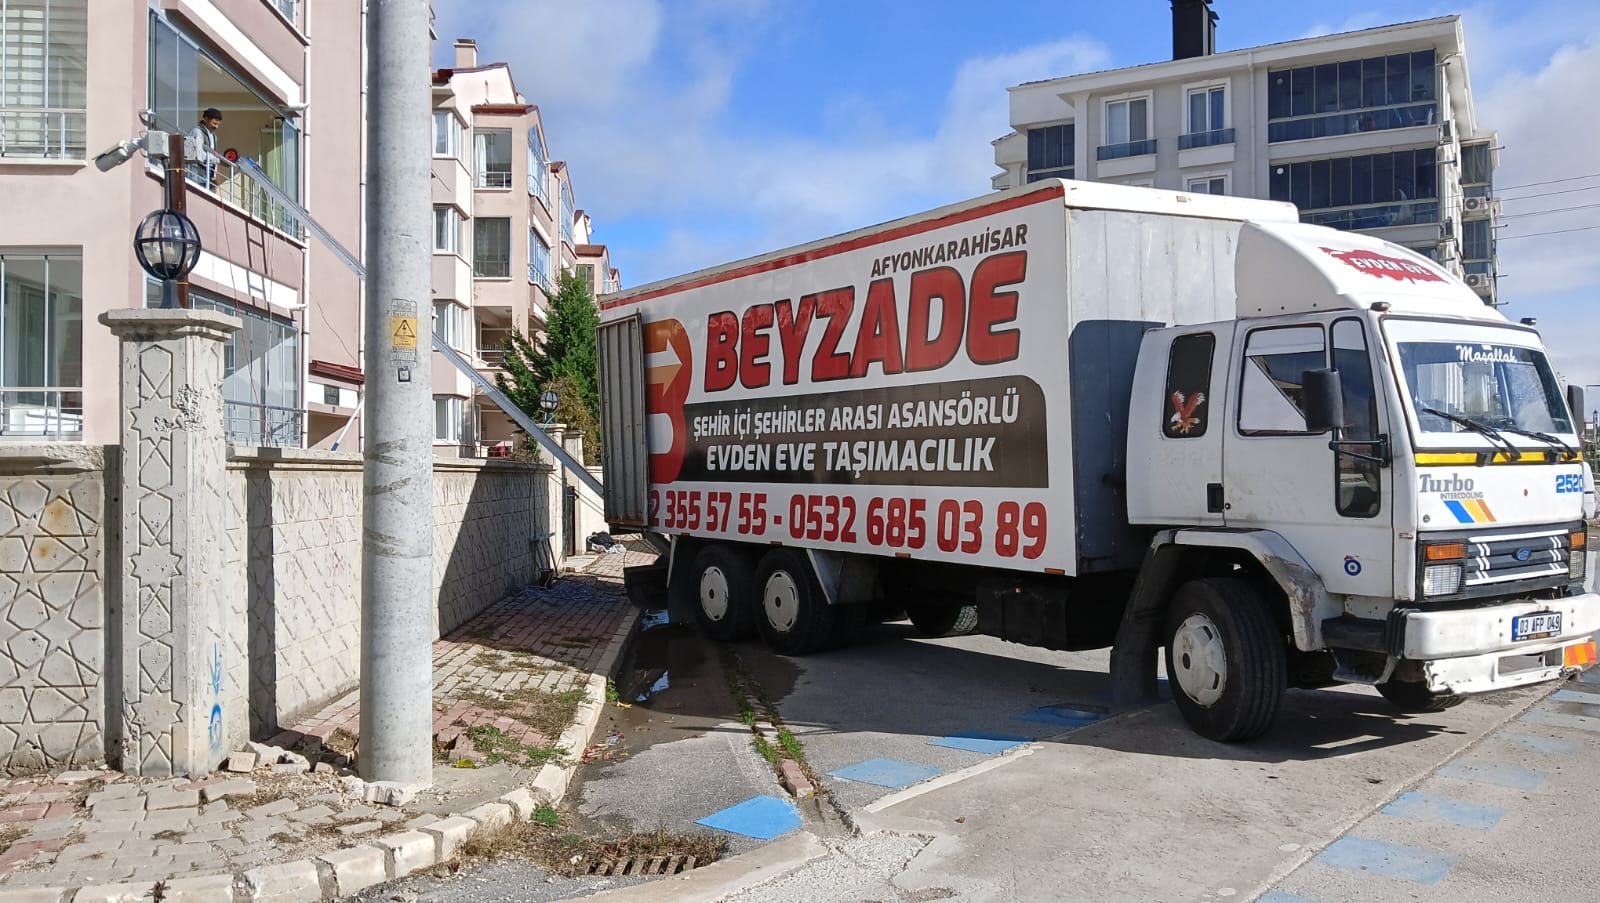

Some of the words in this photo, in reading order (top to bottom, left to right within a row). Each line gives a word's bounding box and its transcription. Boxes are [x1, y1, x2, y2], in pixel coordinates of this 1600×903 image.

[871, 223, 1028, 277] AFYONKARAHİSAR
[1349, 257, 1404, 272] EVDEN
[704, 250, 1027, 392] BEYZADE
[693, 409, 731, 441] ŞEHİR
[733, 408, 751, 440] İÇİ
[754, 404, 826, 439] ŞEHİRLER
[829, 404, 884, 431] ARASI
[887, 387, 1020, 429] ASANSÖRLÜ
[706, 443, 771, 471] EVDEN
[775, 442, 817, 471] EVE
[823, 437, 997, 479] TAŞIMACILIK
[1418, 473, 1475, 493] Turbo
[1440, 491, 1485, 500] INTERCOOLING
[1556, 474, 1584, 493] 2520
[664, 490, 702, 530] 355
[706, 491, 733, 532] 57
[738, 492, 767, 536] 55
[789, 494, 857, 543] 0532
[866, 497, 927, 549] 685
[937, 499, 983, 554] 03
[995, 501, 1048, 559] 89
[1520, 619, 1529, 634] 03
[1531, 616, 1545, 632] AFP
[1546, 615, 1560, 630] 049
